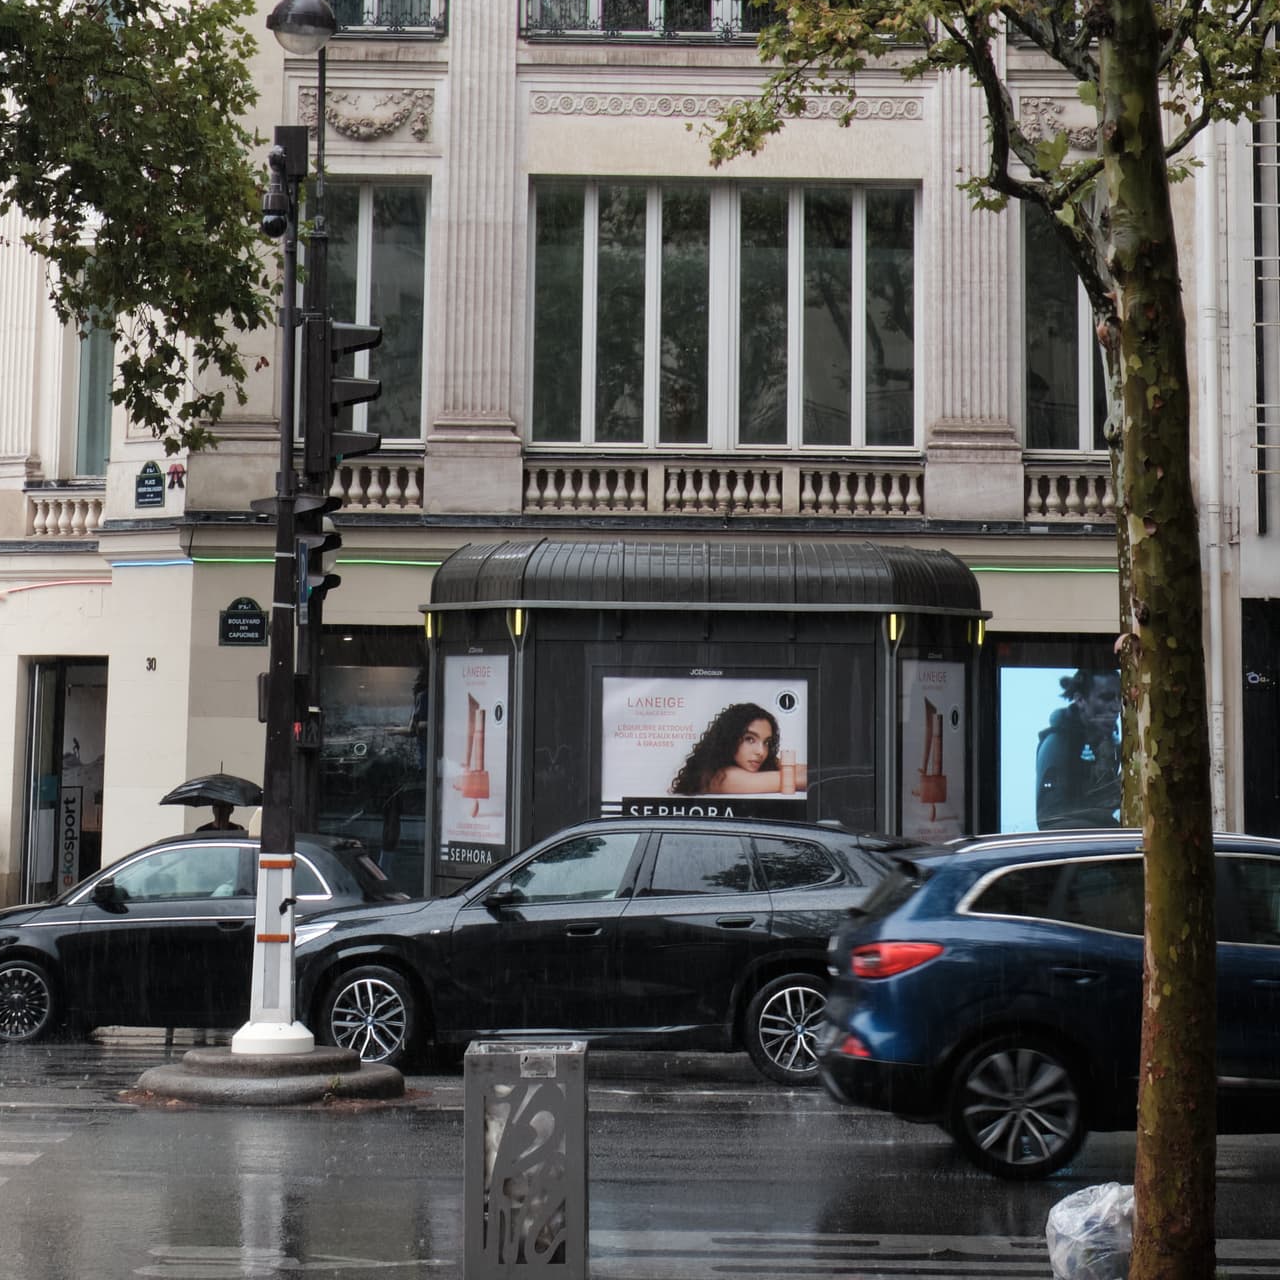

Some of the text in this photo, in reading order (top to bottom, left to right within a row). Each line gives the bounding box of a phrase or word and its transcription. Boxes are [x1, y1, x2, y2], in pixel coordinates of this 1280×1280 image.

[146, 657, 157, 672] 30
[689, 669, 723, 677] JCDecaux
[627, 696, 685, 708] LANEIGE
[629, 806, 735, 817] SEPHORA
[62, 796, 79, 887] ekosport
[450, 847, 493, 865] SEPHORA
